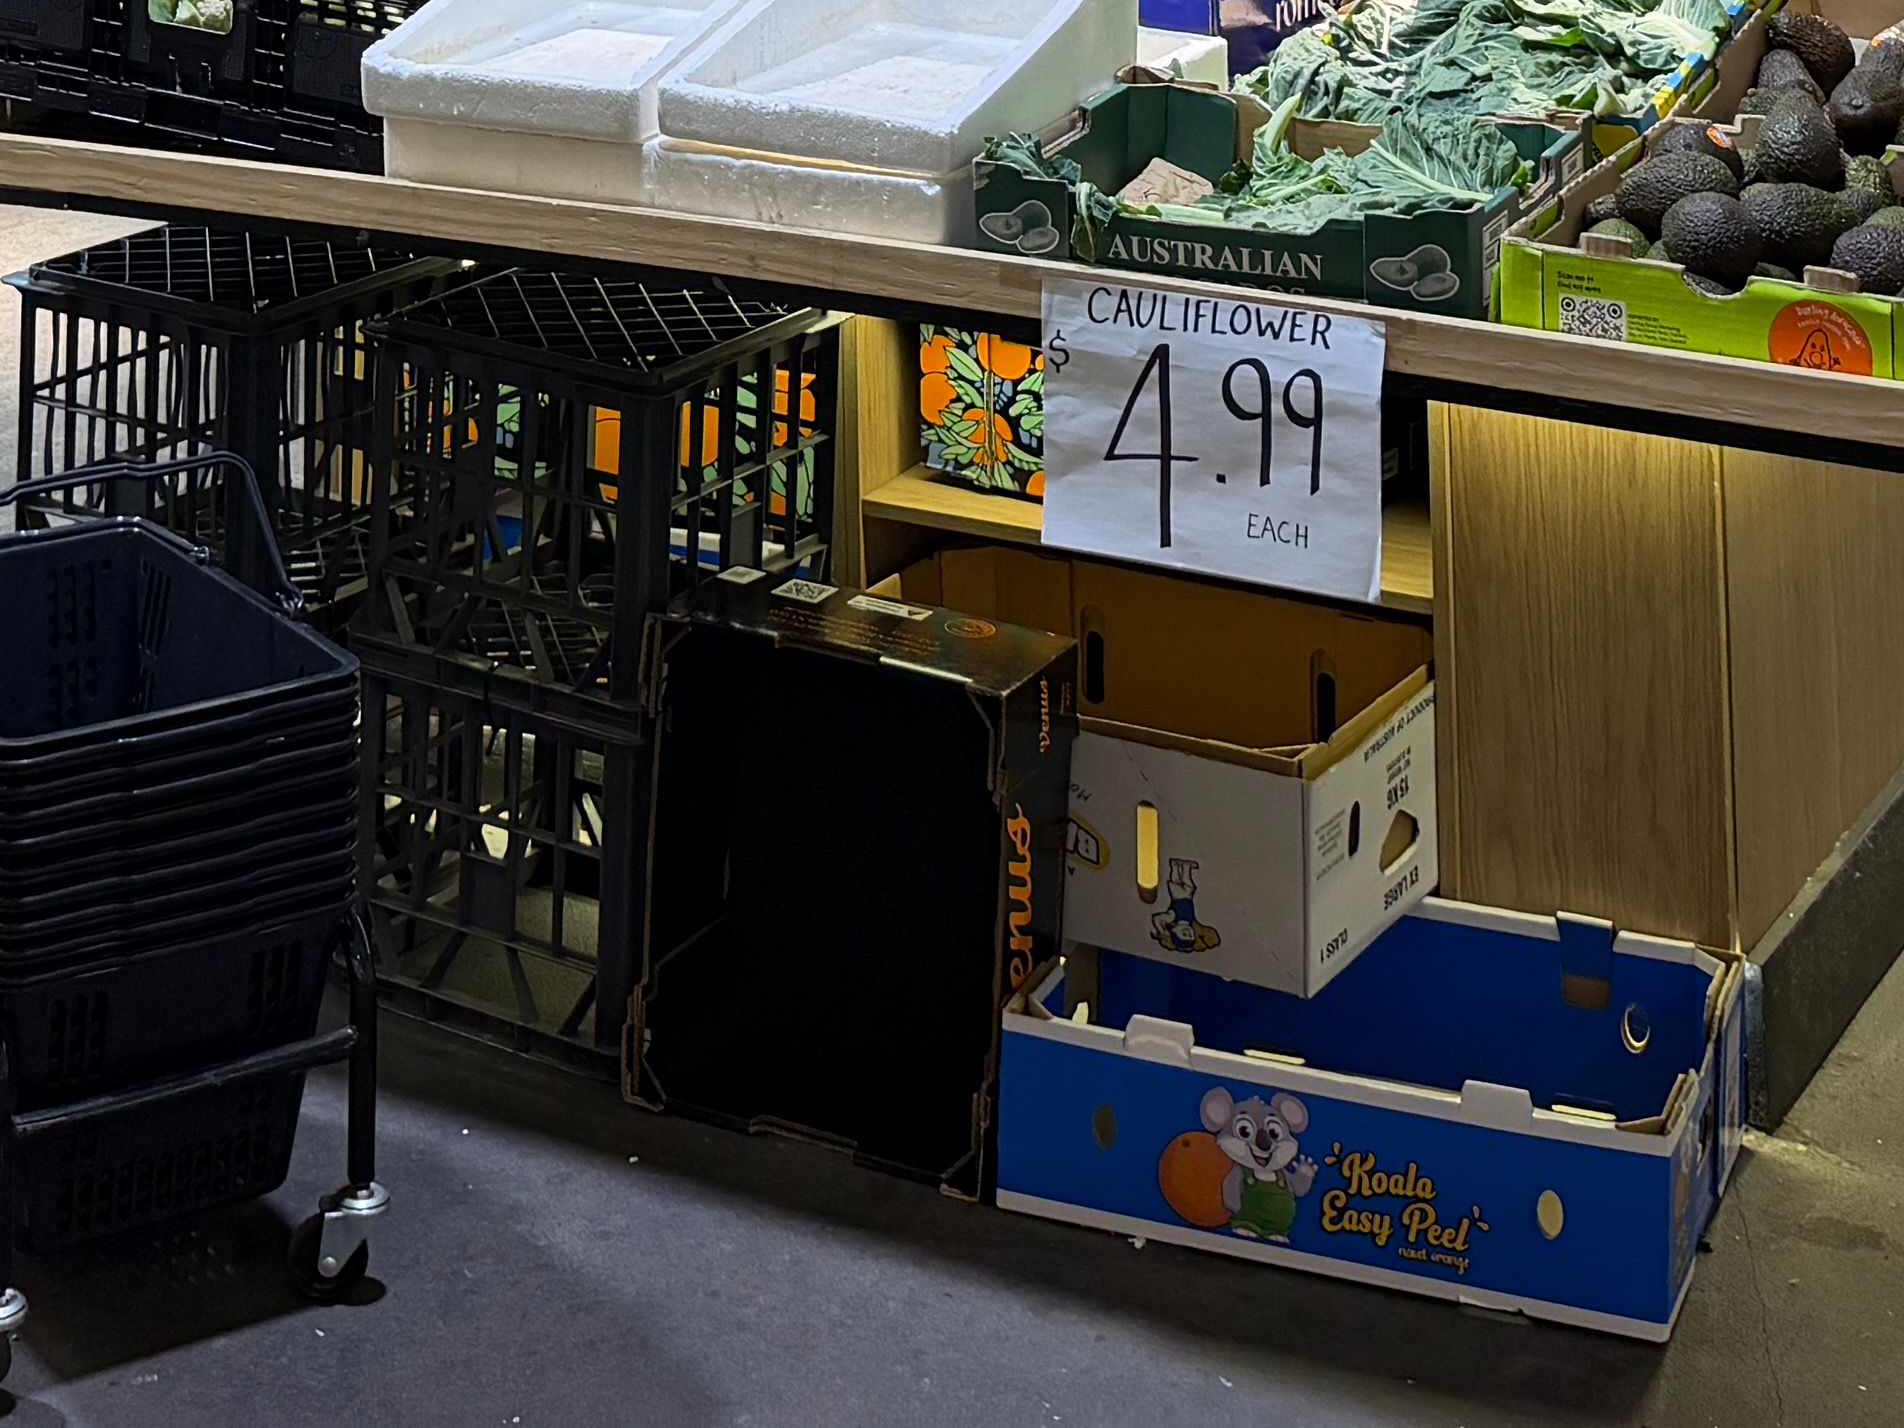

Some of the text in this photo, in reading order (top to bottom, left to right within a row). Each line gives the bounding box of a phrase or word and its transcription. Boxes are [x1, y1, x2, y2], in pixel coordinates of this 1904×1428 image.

[1108, 235, 1323, 281] AUSTRALIAN
[1087, 287, 1332, 350] CAULIFLOWER
[1103, 343, 1323, 548] 4.99
[1247, 513, 1309, 549] EACH
[1006, 802, 1034, 989] enus
[1384, 865, 1419, 911] EX LARGE
[1326, 928, 1348, 960] CLASS
[1342, 1152, 1436, 1199] Koala
[1322, 1189, 1470, 1252] Easy Peel
